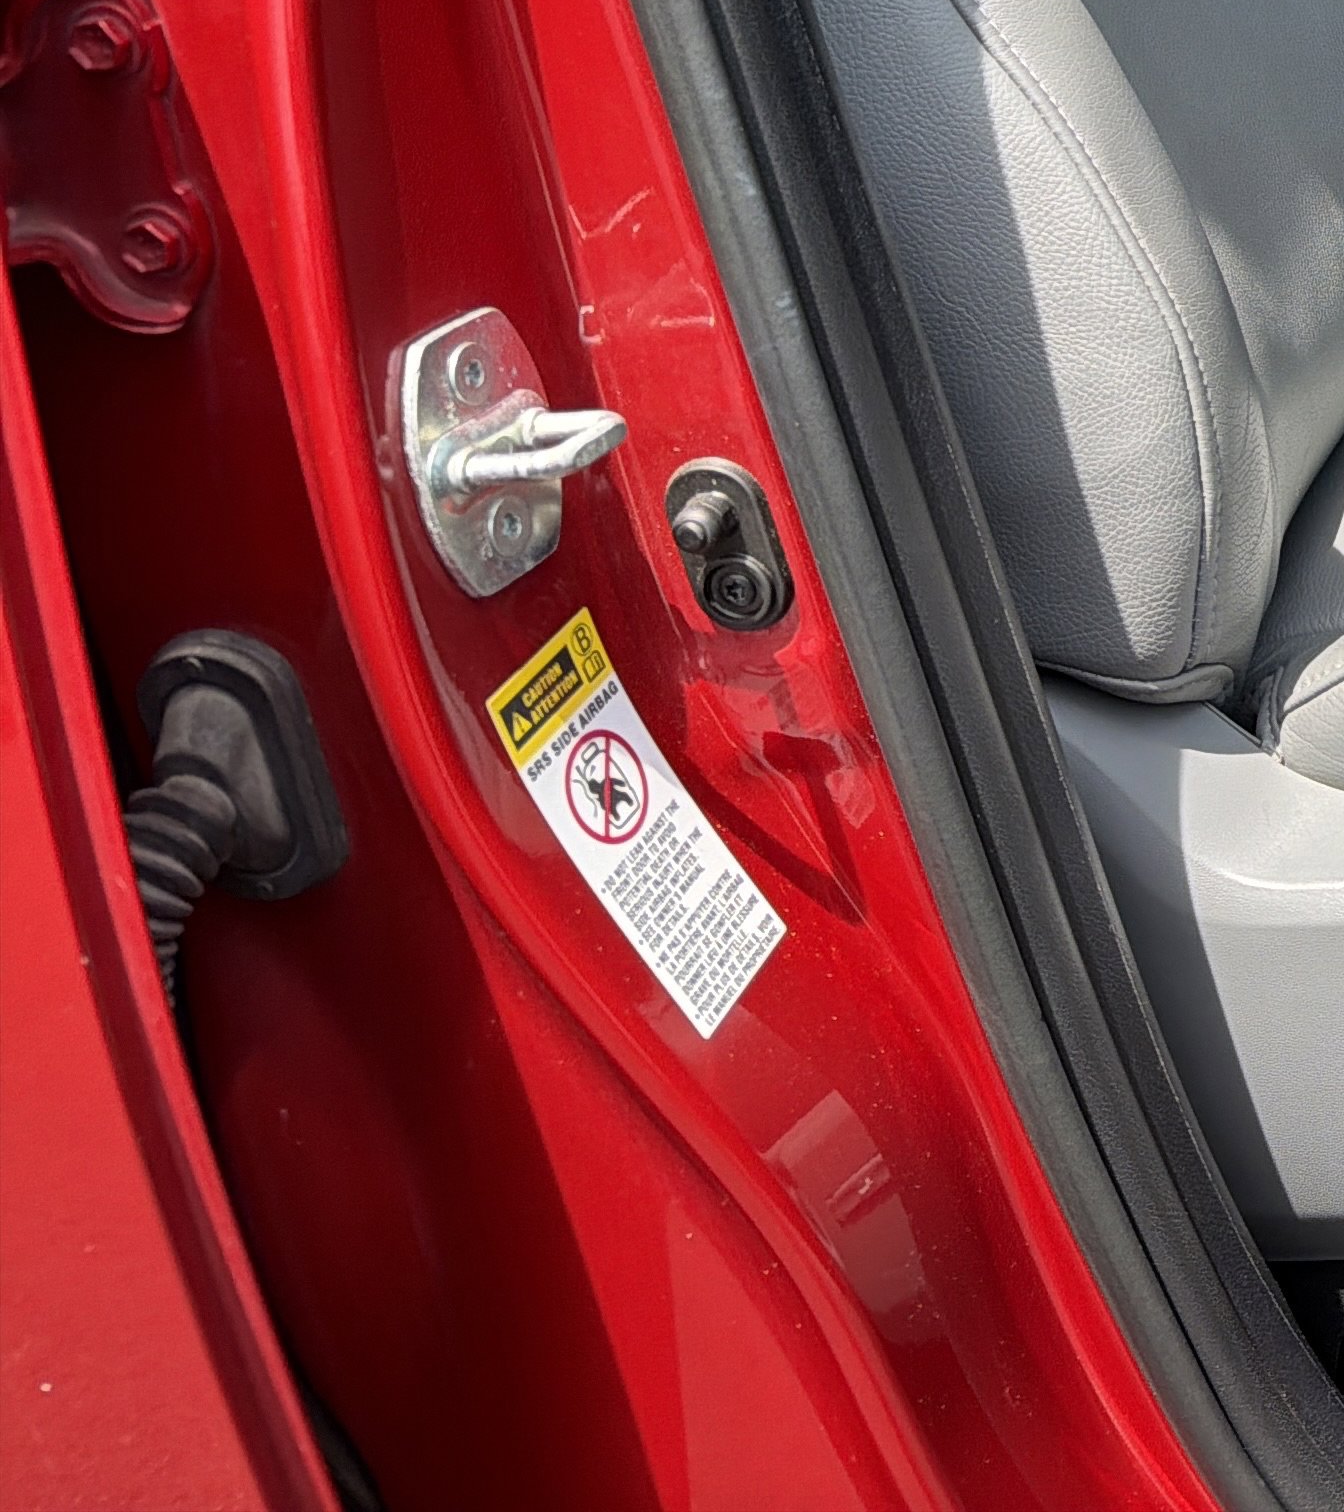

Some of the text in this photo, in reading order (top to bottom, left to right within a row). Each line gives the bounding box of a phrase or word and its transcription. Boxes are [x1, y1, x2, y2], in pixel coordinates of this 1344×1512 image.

[572, 623, 593, 654] B
[519, 659, 564, 710] CAUTION
[528, 668, 579, 726] ATTENTION
[525, 677, 619, 783] SRS SIDE AIRBAG
[624, 840, 645, 865] LEAN
[639, 811, 669, 846] AGAINST
